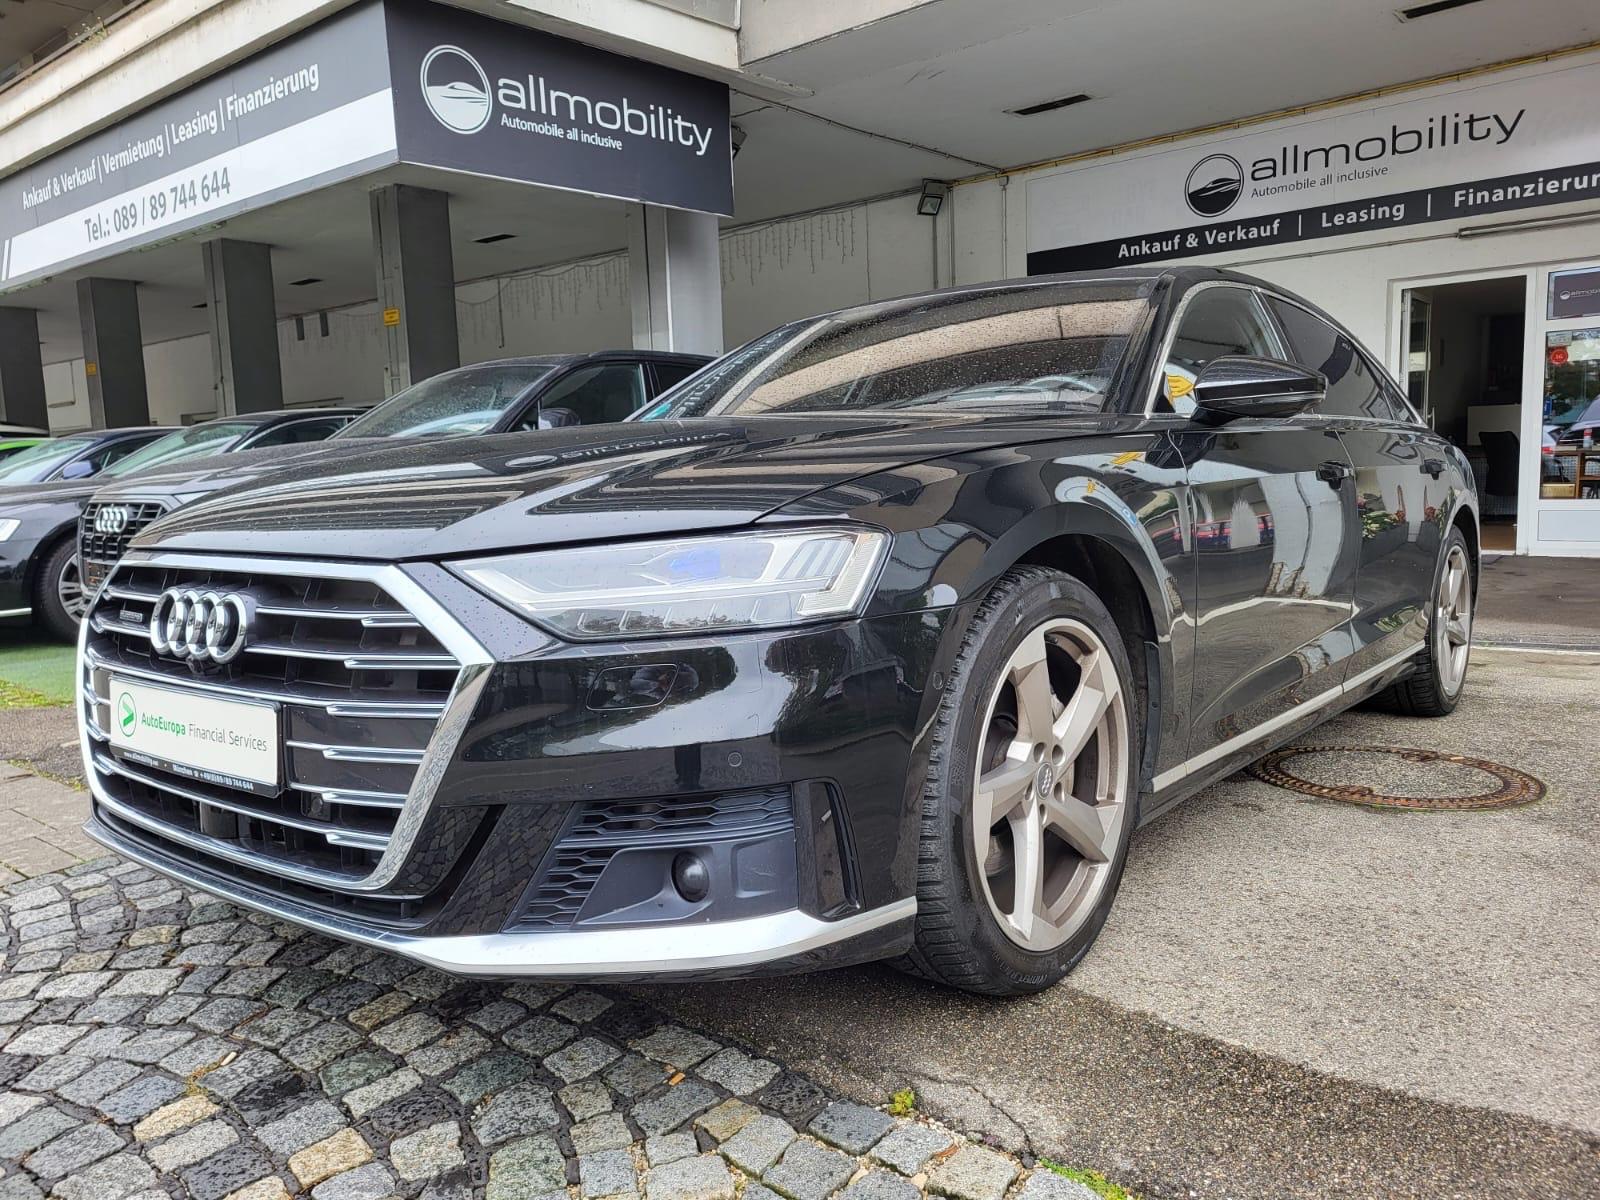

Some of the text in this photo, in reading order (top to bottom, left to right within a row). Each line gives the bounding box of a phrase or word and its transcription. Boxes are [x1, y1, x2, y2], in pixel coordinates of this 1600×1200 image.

[22, 179, 52, 210] Ankauf
[53, 177, 61, 197] &
[60, 158, 97, 194] Verkauf
[102, 133, 165, 174] Vermietung
[171, 108, 218, 145] Leasing
[226, 63, 319, 121] Finanzierung
[497, 74, 713, 156] allmobility
[501, 113, 622, 150] Automobile all inclusive
[1251, 109, 1526, 181] allmobility
[84, 212, 111, 243] Tel.:
[113, 203, 137, 233] 089
[150, 191, 167, 220] 89
[170, 180, 198, 213] 744
[201, 167, 231, 202] 644
[1251, 165, 1388, 198] Automobile all inclusive
[1118, 234, 1181, 259] Ankauf
[1185, 233, 1199, 248] &
[1205, 219, 1281, 245] Verkauf
[1321, 202, 1405, 228] Leasing
[141, 712, 267, 752] AutoEuropa Financial Services
